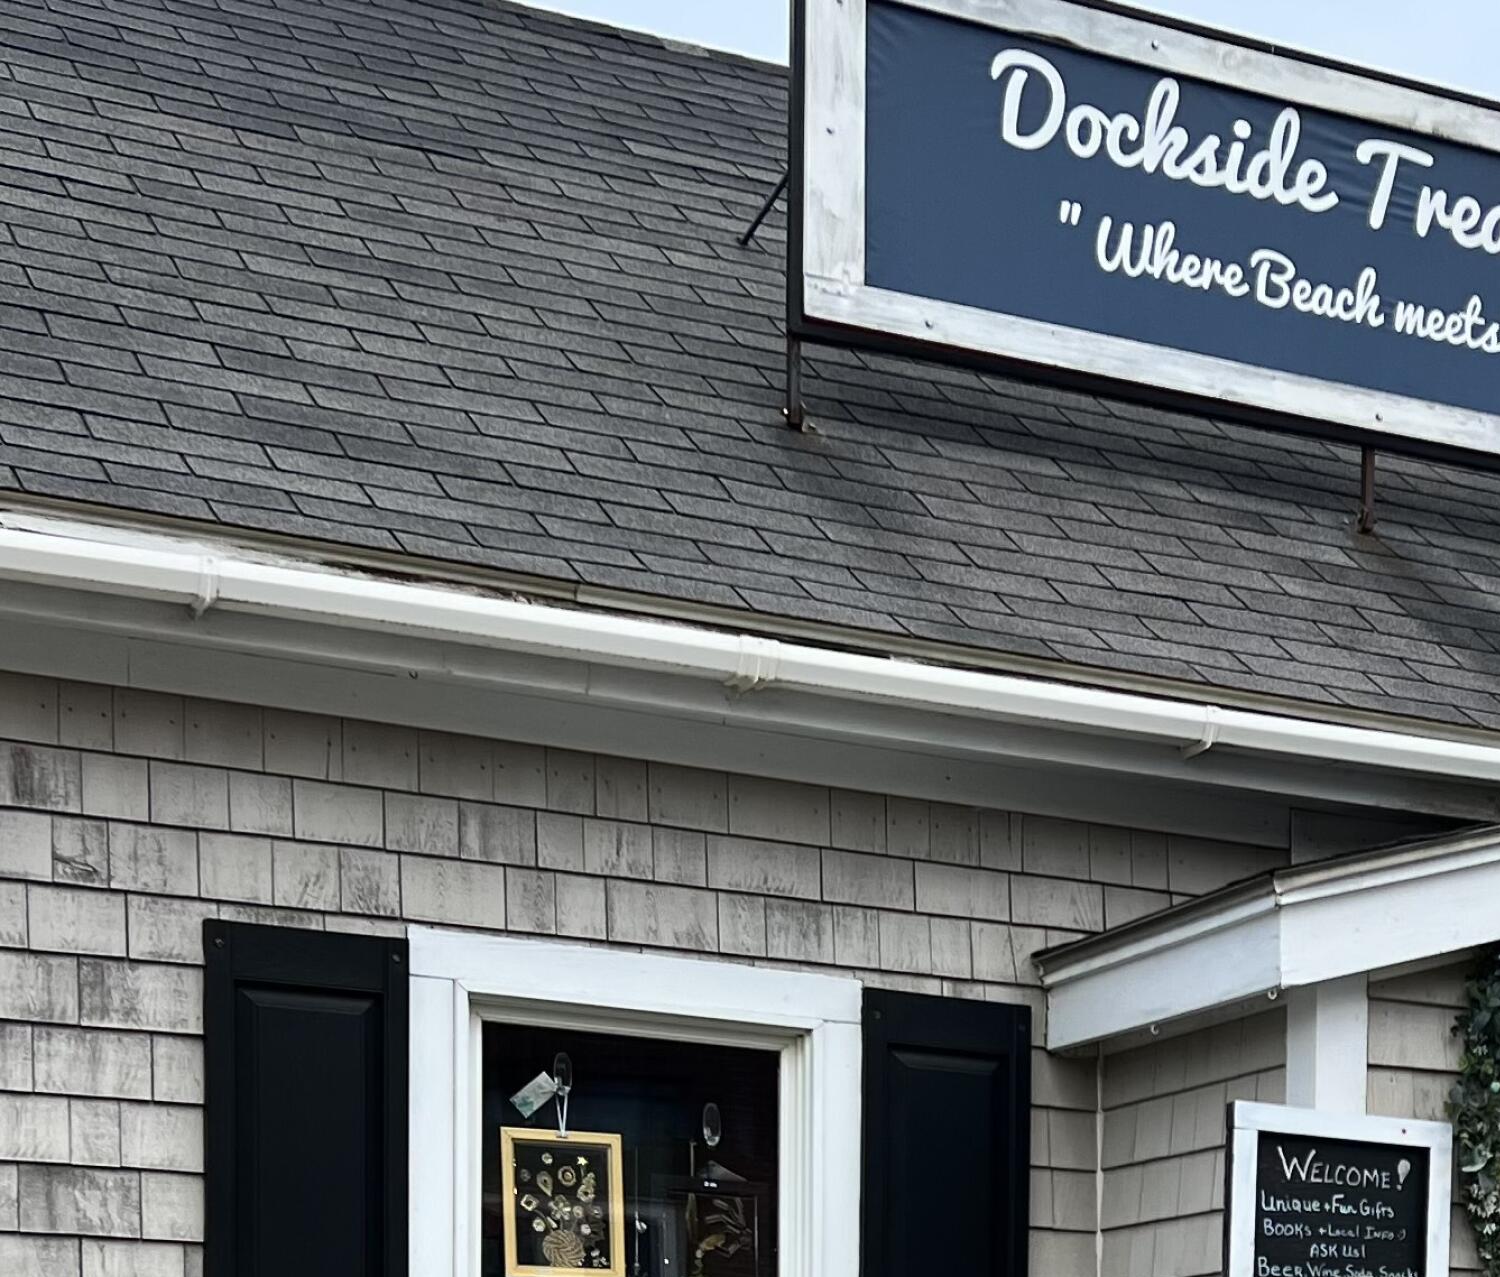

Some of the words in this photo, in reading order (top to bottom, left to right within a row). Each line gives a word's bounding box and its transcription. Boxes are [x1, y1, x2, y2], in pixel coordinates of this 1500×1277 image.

[991, 49, 1339, 213] Dockside
[1250, 248, 1384, 328] Beach
[1261, 1189, 1321, 1213] Unique
[1310, 1244, 1338, 1258] ASK
